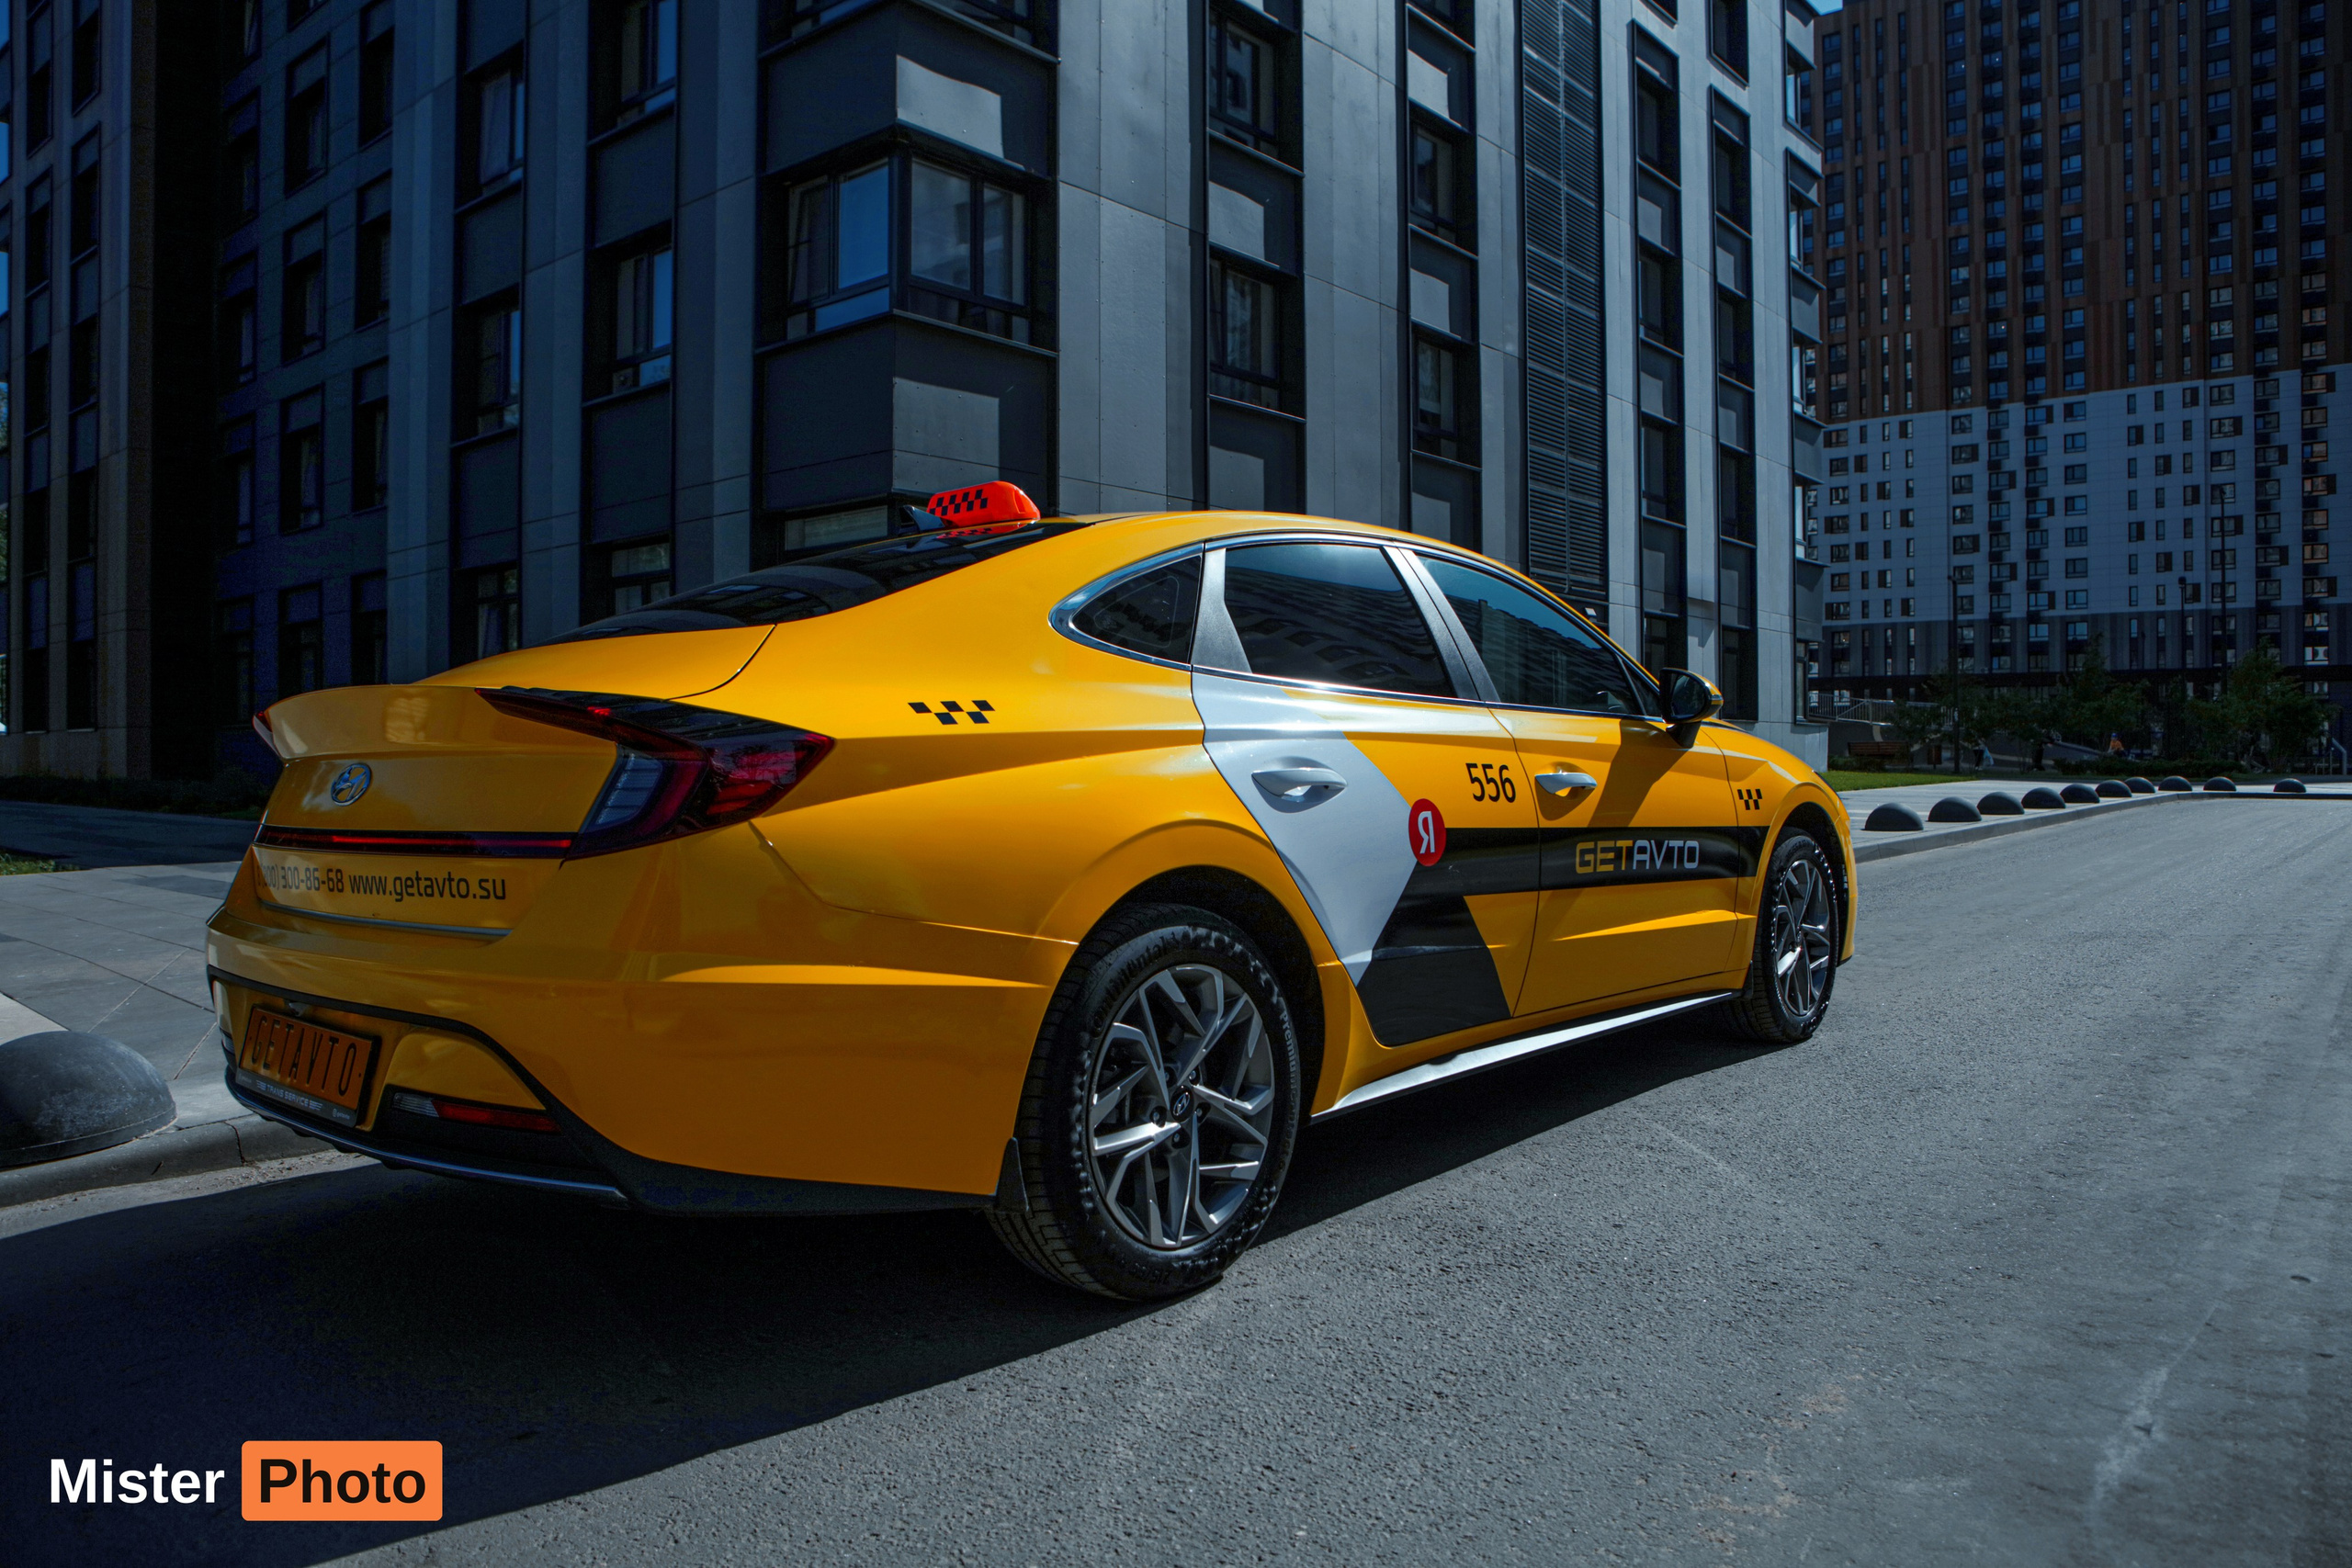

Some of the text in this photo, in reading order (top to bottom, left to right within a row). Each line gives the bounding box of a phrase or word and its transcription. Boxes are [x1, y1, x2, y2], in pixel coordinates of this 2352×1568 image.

[1465, 763, 1517, 803] 556
[1417, 810, 1436, 855] Я
[1575, 840, 1701, 874] GETAVTO
[348, 871, 506, 903] www.getavto.su
[252, 1016, 357, 1097] GETAVTO
[266, 1084, 310, 1107] TRANS SERVICE
